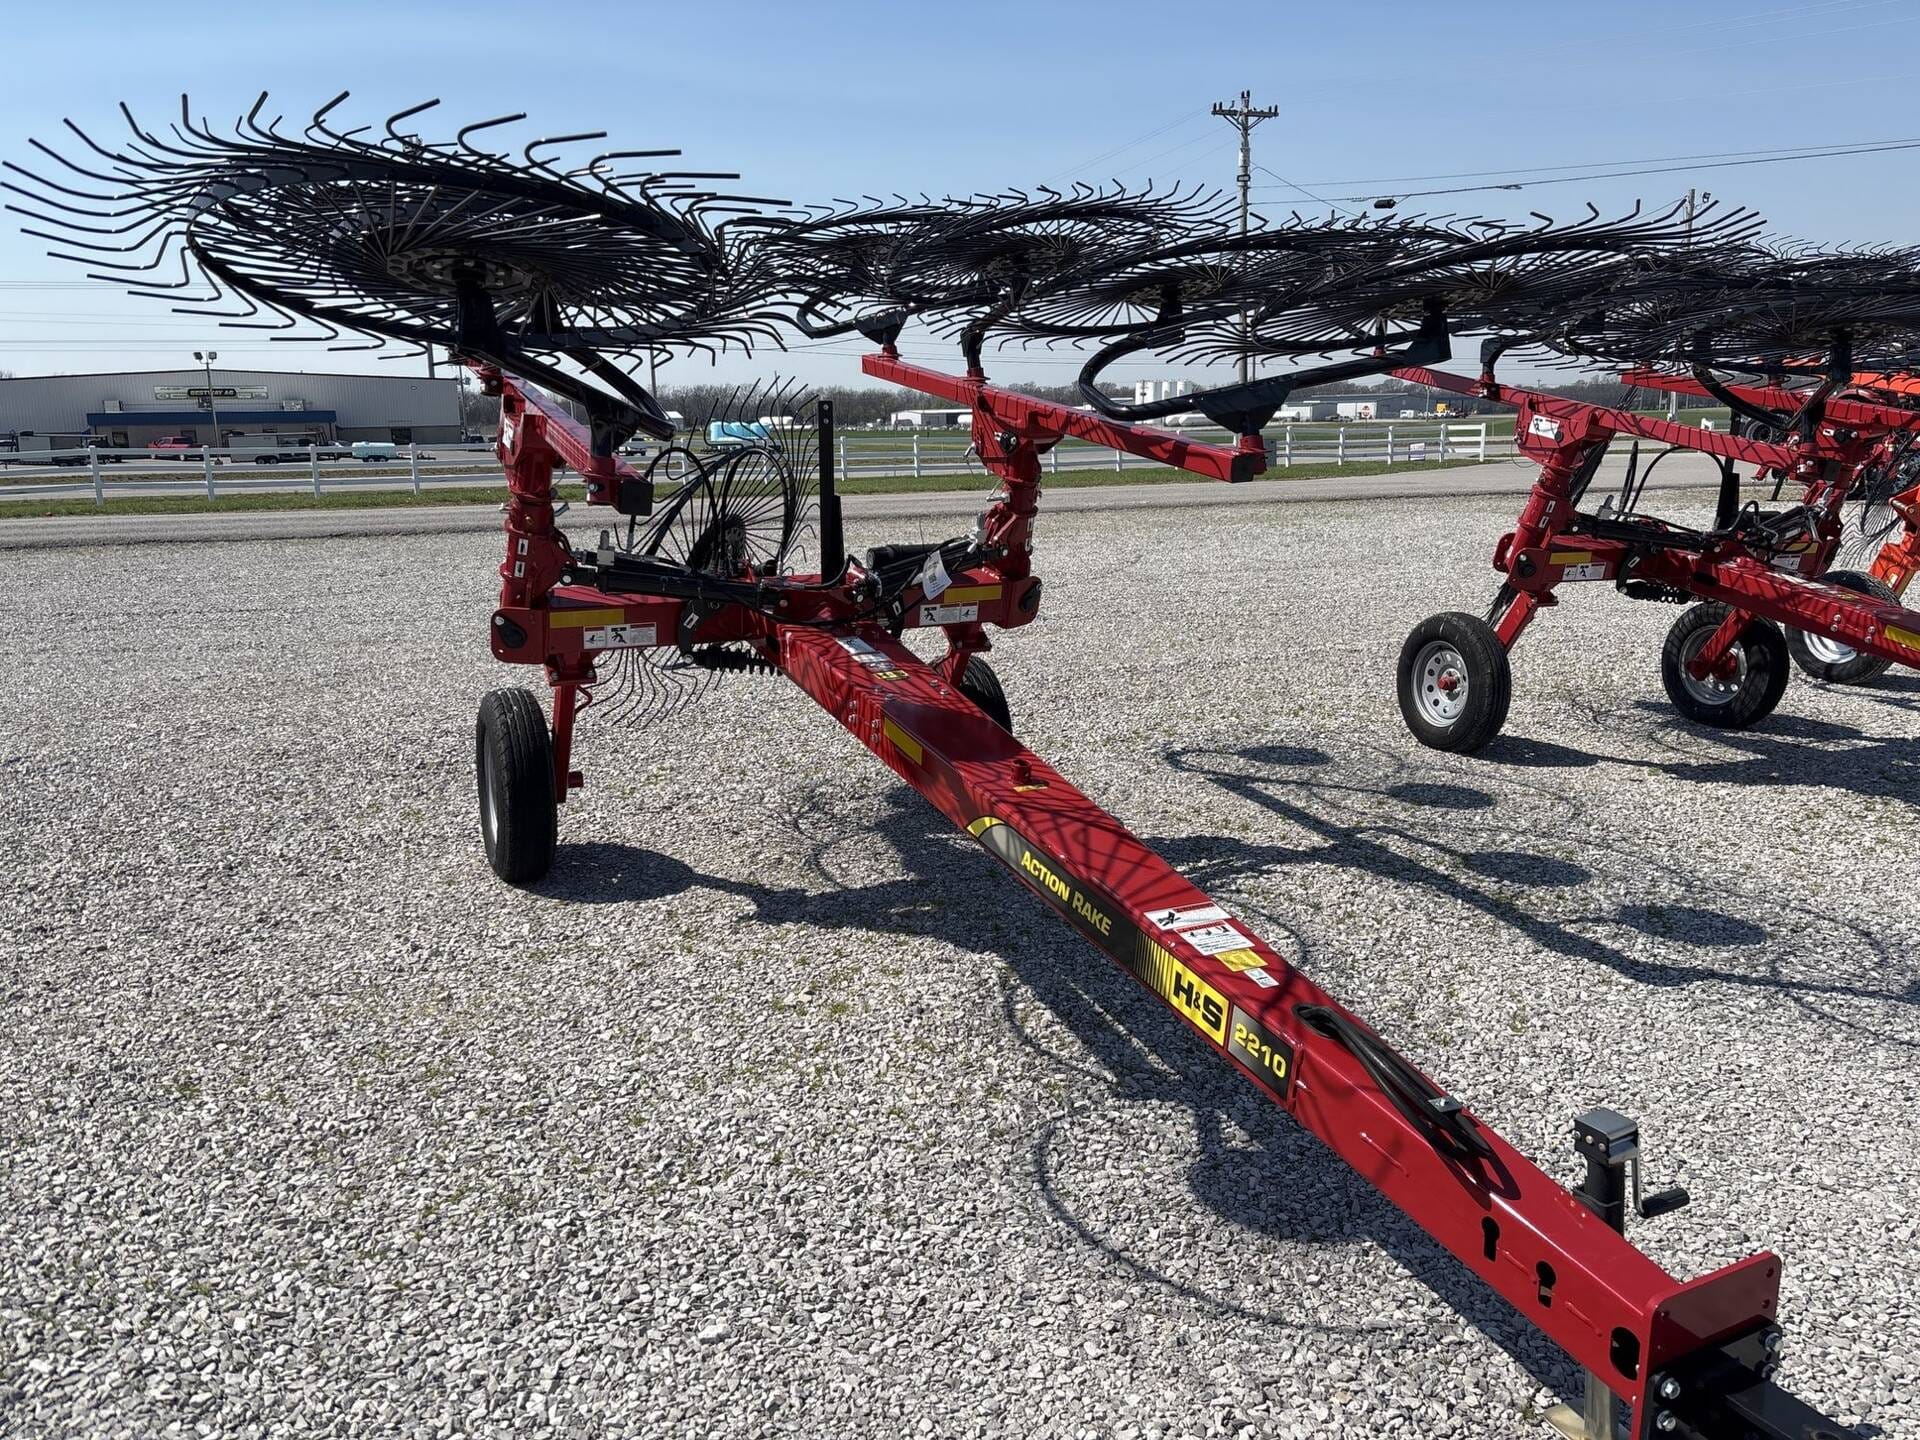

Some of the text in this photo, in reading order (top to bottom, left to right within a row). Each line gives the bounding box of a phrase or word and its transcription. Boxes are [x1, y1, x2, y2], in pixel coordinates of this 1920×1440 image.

[1021, 850, 1112, 936] ACTION RAKE
[1173, 970, 1224, 1032] H&S
[1234, 1023, 1287, 1078] 2210
